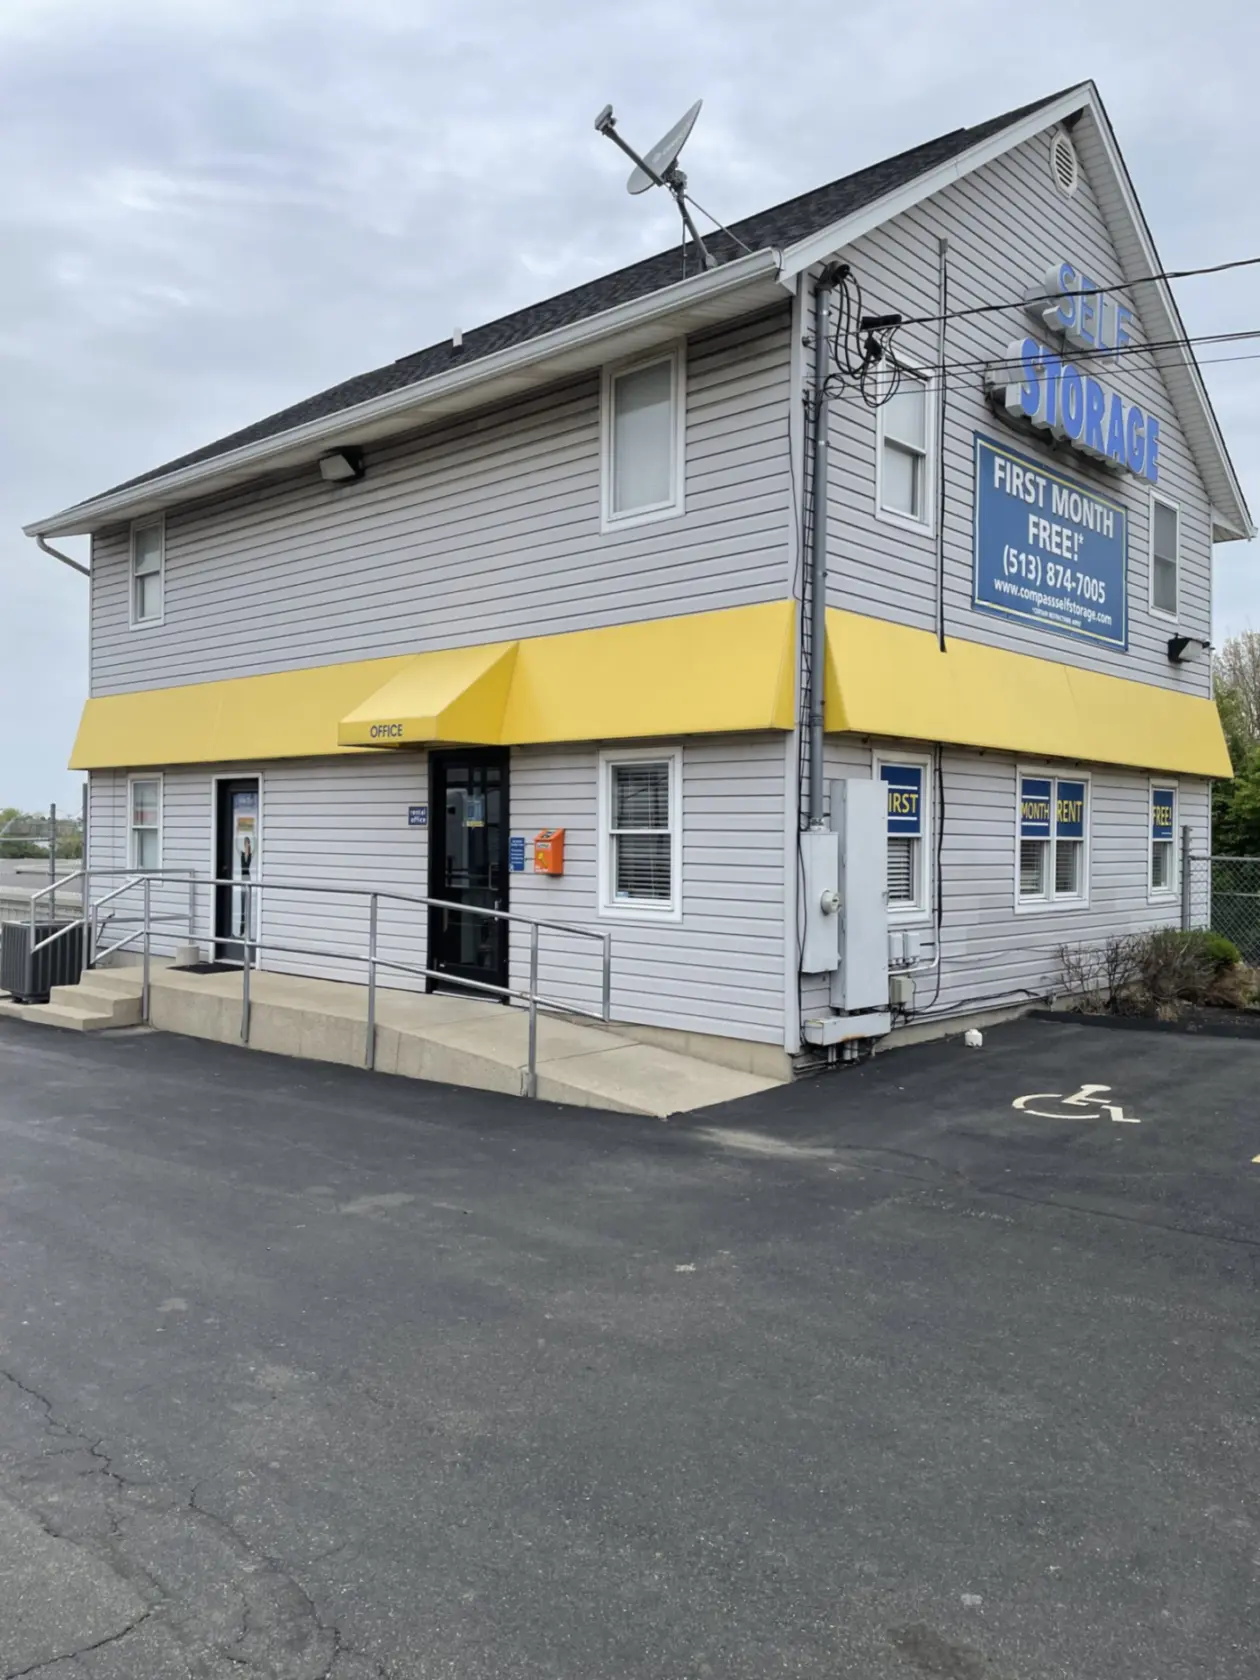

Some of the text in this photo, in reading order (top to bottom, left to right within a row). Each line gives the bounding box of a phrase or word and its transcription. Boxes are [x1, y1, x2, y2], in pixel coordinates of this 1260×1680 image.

[1046, 262, 1133, 362] SELF
[1010, 337, 1160, 484] STORAGE
[993, 456, 1115, 539] FIRST MONTH
[1003, 544, 1106, 604] (513) 874-7005
[994, 578, 1113, 626] www.compassselfstorage.com
[370, 724, 403, 738] OFFICE
[888, 793, 918, 813] IRST
[1021, 802, 1050, 820] MONTH
[1057, 800, 1082, 823] RENT
[1152, 805, 1172, 826] FREE!
